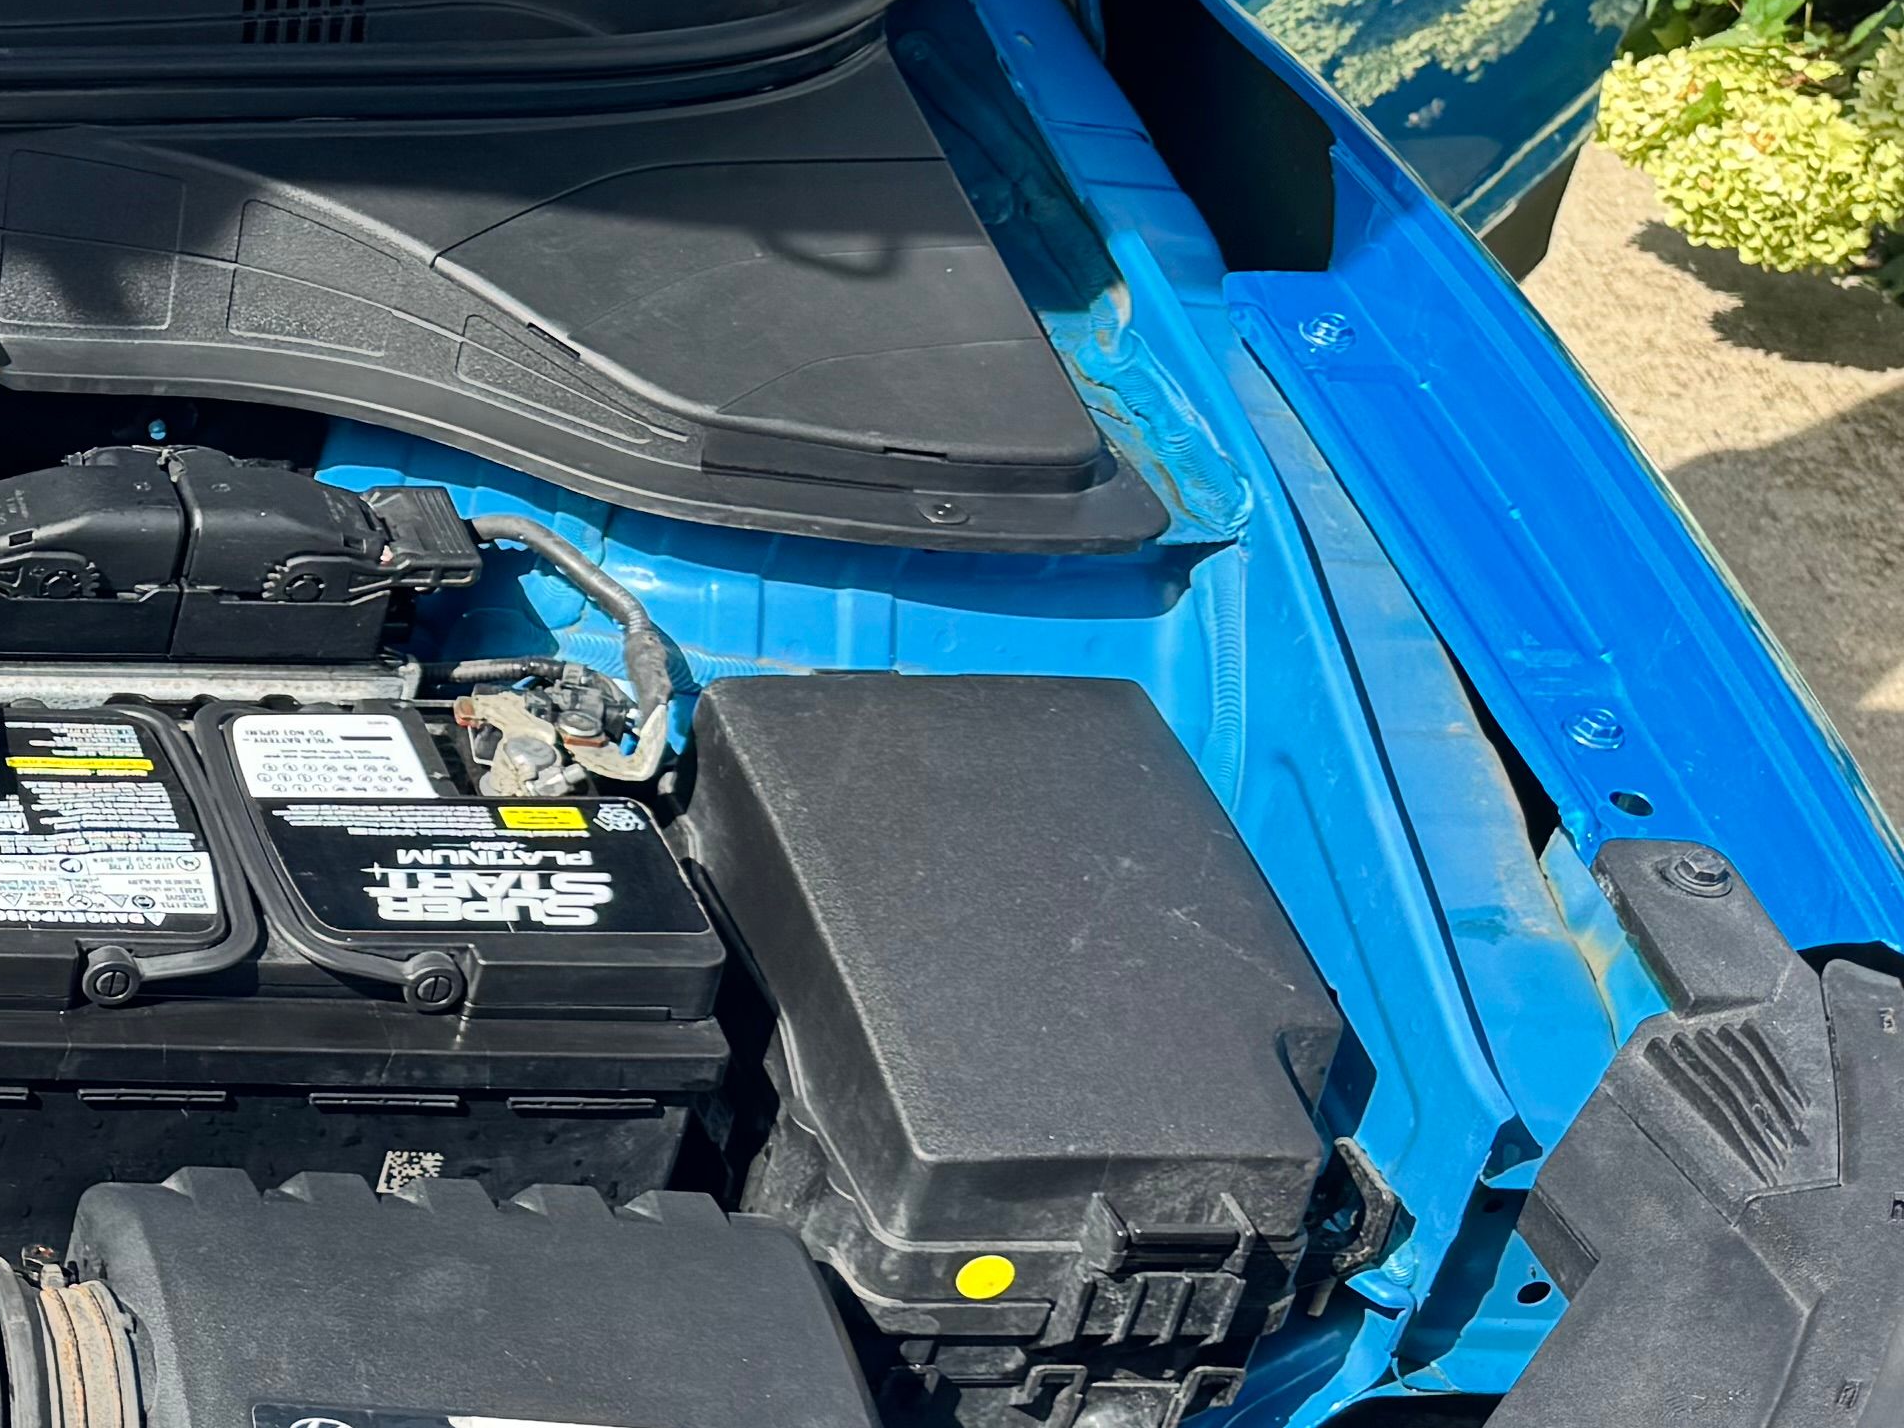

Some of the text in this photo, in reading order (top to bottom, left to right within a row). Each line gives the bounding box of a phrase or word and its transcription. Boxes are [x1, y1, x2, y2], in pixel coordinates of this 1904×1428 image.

[396, 848, 593, 865] PLATINUM
[362, 872, 613, 904] START
[377, 895, 598, 926] SUPER
